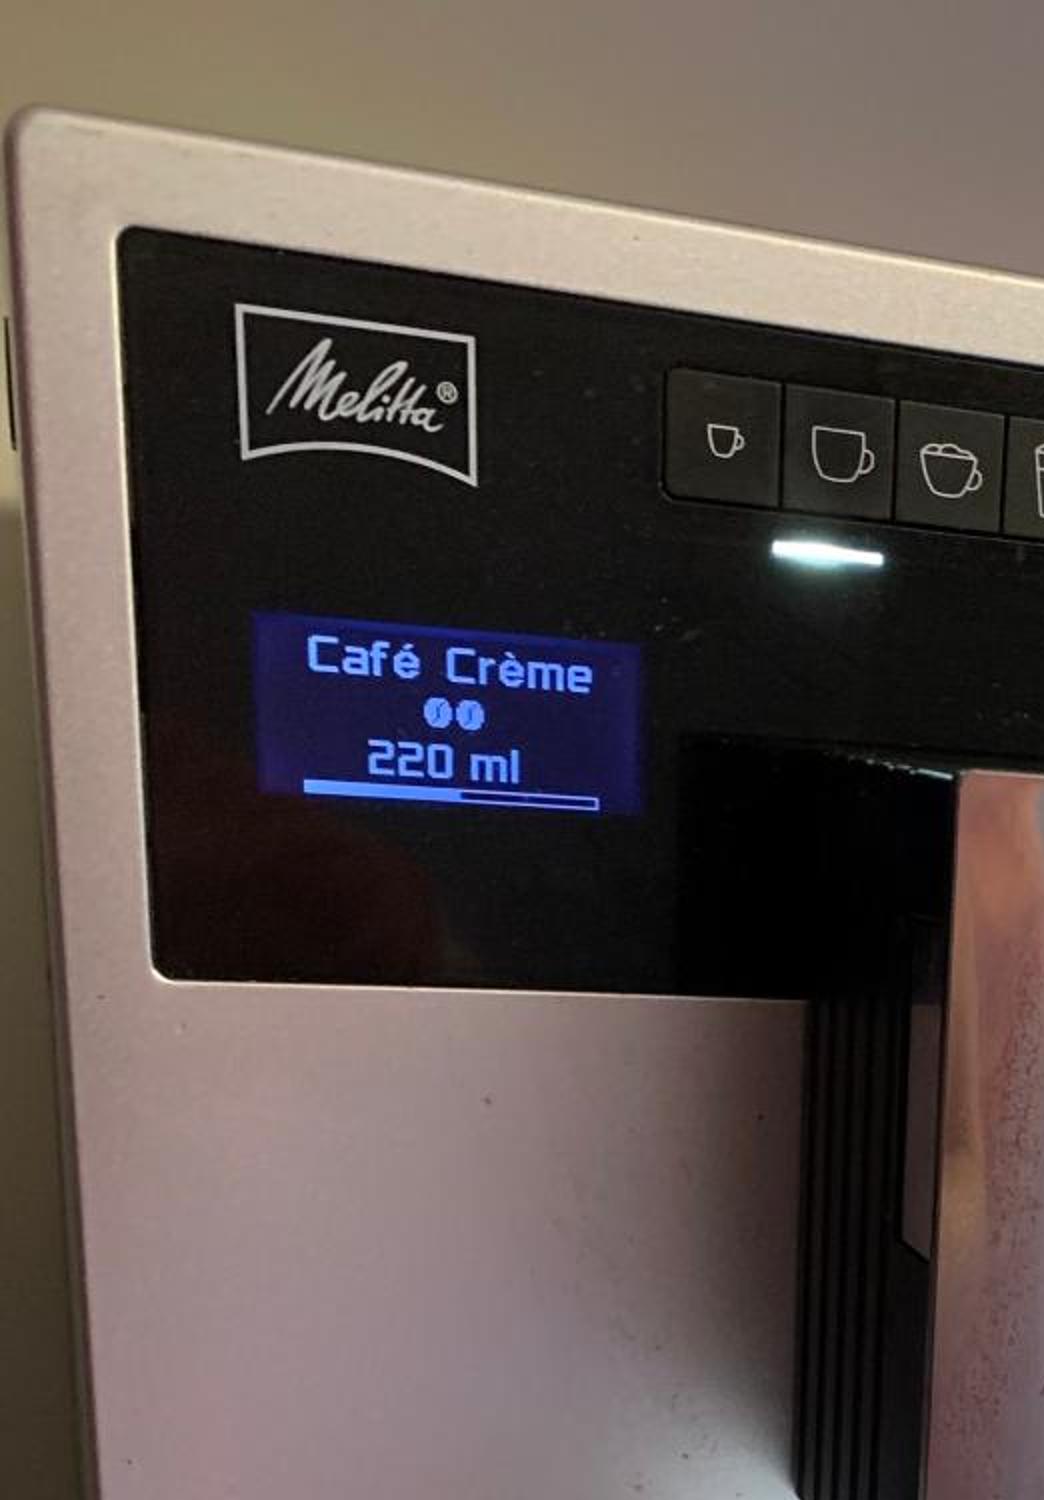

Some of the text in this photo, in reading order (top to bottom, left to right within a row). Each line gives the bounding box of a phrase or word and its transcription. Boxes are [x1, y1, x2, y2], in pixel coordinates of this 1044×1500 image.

[307, 634, 593, 693] Café Crème
[368, 738, 521, 785] 220 ml
